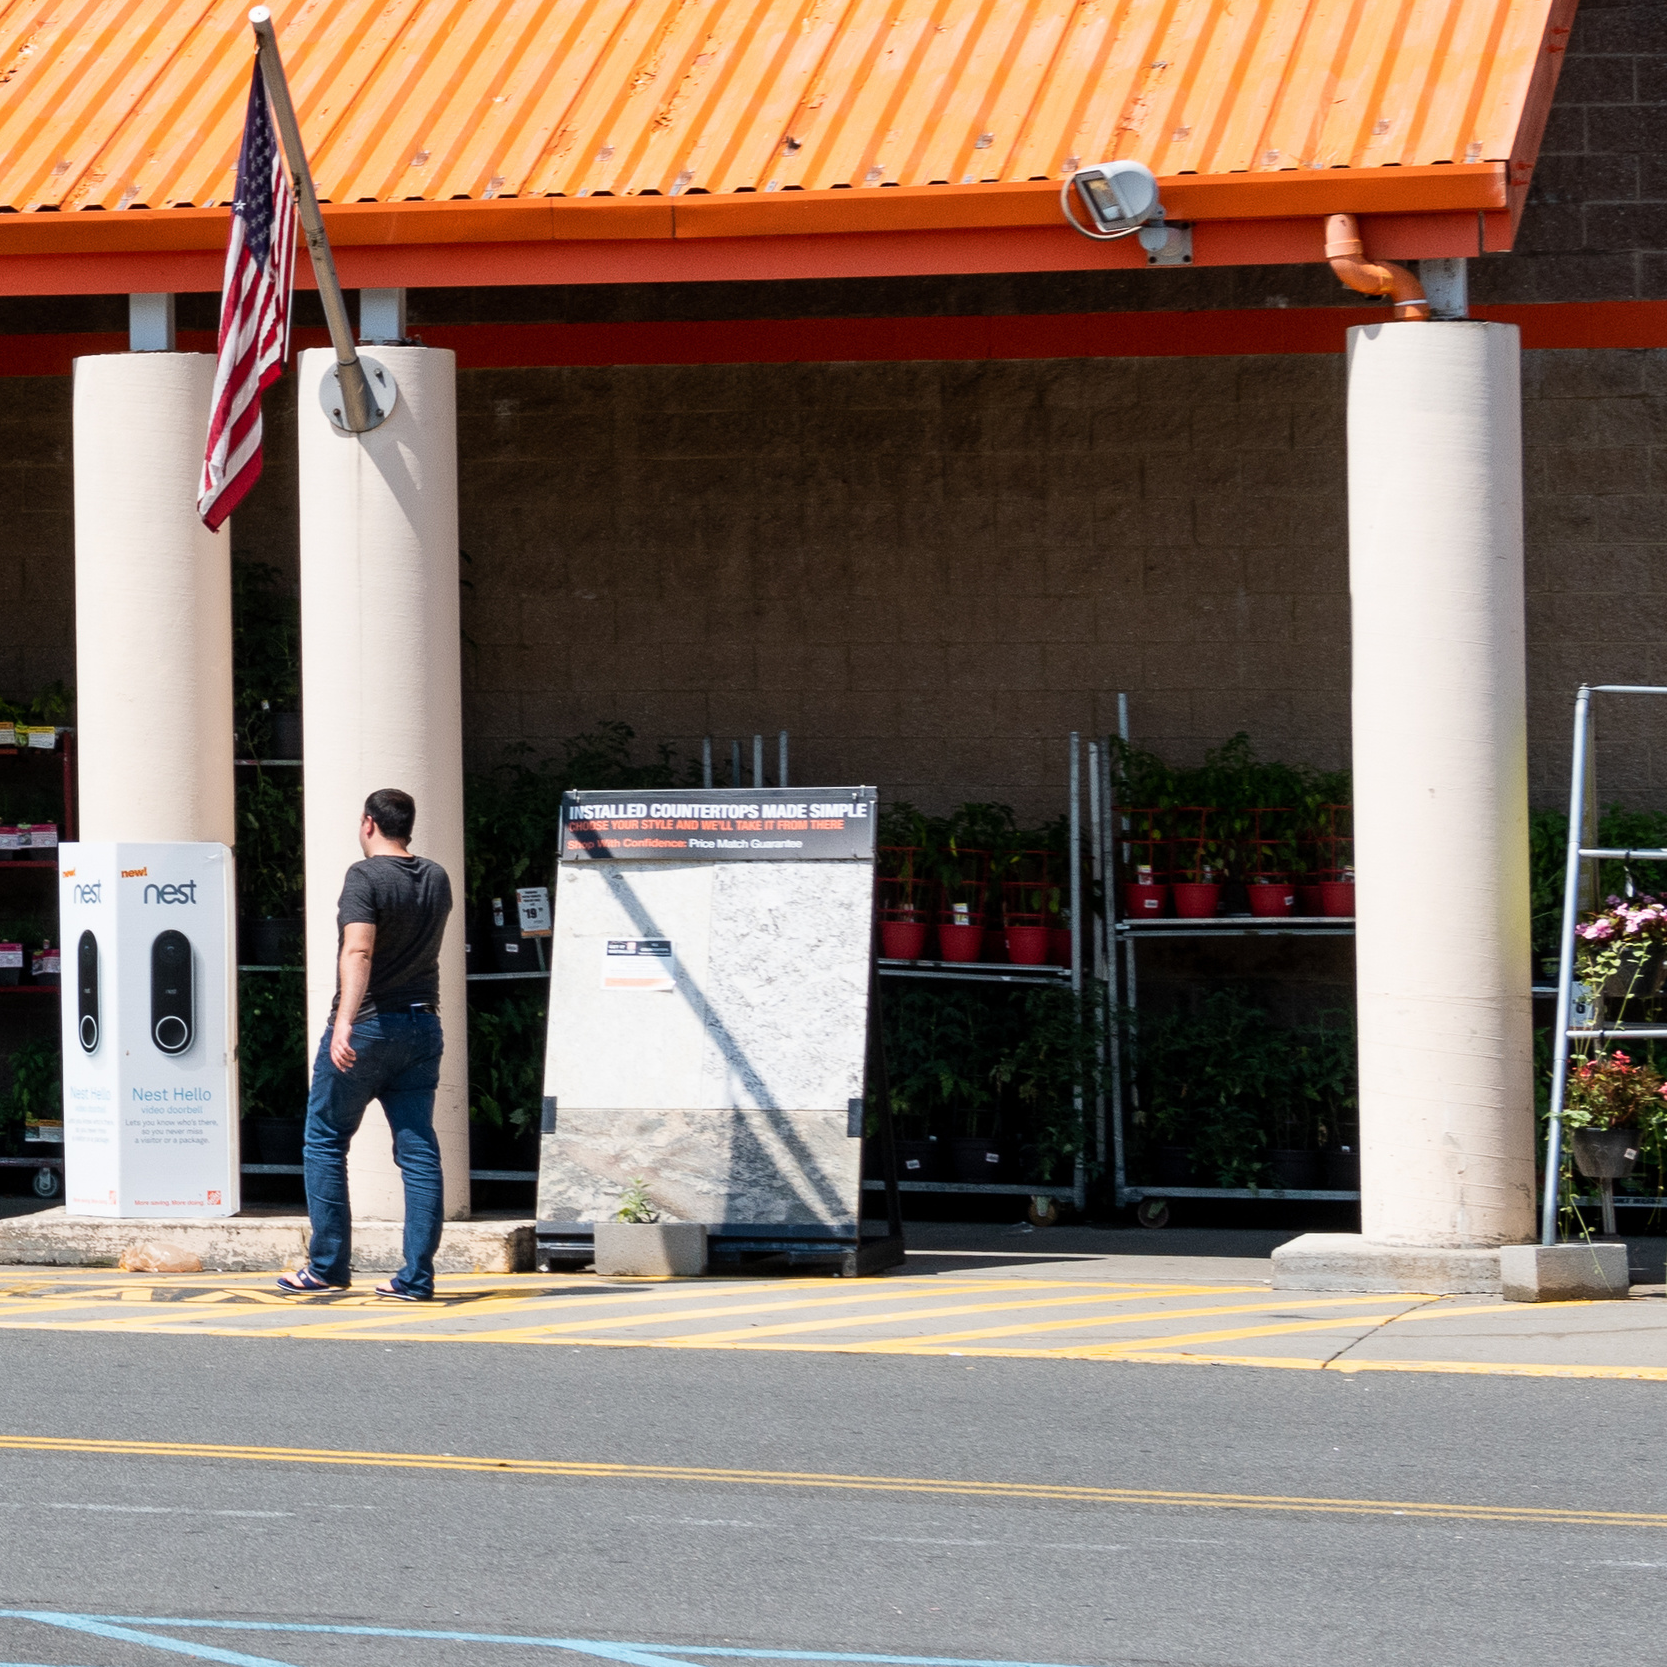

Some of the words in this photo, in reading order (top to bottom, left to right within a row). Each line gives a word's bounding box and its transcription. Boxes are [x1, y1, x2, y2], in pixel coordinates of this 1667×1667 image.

[569, 803, 647, 820] INSTALLED
[650, 803, 759, 819] COUNTERTOPS
[761, 804, 807, 818] MADE
[809, 803, 867, 818] SIMPLE
[569, 820, 609, 832] CHOOSE
[611, 820, 639, 830] YOUR
[641, 819, 674, 830] STYLE
[675, 820, 699, 830] AND
[701, 820, 733, 831] WE'LL
[735, 820, 763, 831] TAKE
[764, 820, 774, 830] IT
[777, 820, 808, 830] FROM
[810, 819, 845, 830] THERE
[567, 840, 594, 850] Shop
[597, 838, 620, 848] With
[623, 838, 687, 848] Confidence:
[689, 838, 715, 848] Price
[717, 838, 749, 848] Match
[750, 838, 803, 849] Guarantee
[121, 866, 148, 878] new!
[74, 879, 101, 904] nest
[144, 879, 197, 904] nest
[132, 1087, 168, 1101] Nest
[173, 1087, 212, 1101] Hello
[141, 1105, 164, 1114] video
[167, 1105, 203, 1114] doorbell
[198, 1119, 218, 1127] there,
[179, 1137, 210, 1145] package.
